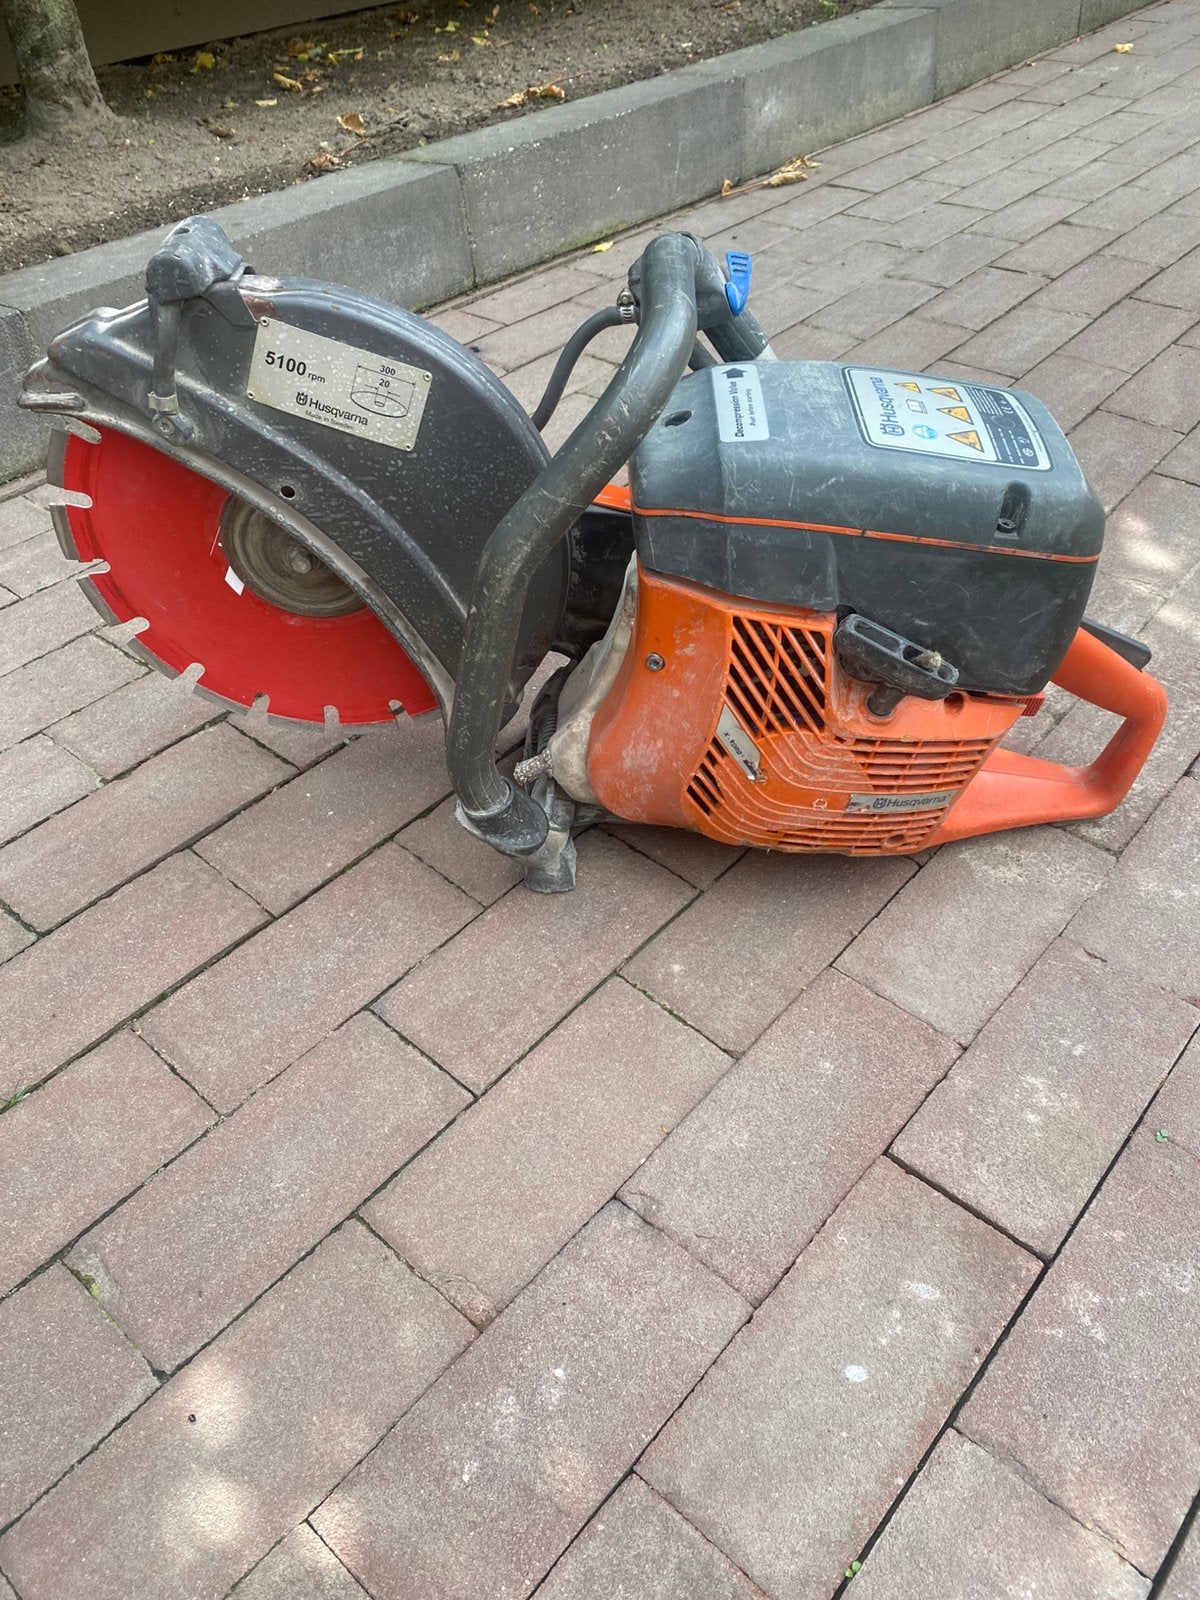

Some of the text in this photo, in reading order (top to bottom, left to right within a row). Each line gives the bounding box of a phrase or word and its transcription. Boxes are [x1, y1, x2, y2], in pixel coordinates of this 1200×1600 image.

[265, 350, 326, 383] 5100 rpm
[379, 364, 397, 376] 300
[379, 378, 391, 388] 20
[308, 396, 369, 426] Husqvarna
[728, 381, 744, 438] Decompression Valve
[869, 376, 899, 424] Husqvarna
[305, 409, 323, 420] Made
[330, 417, 355, 430] Sweden
[886, 794, 948, 808] Husqvarna
